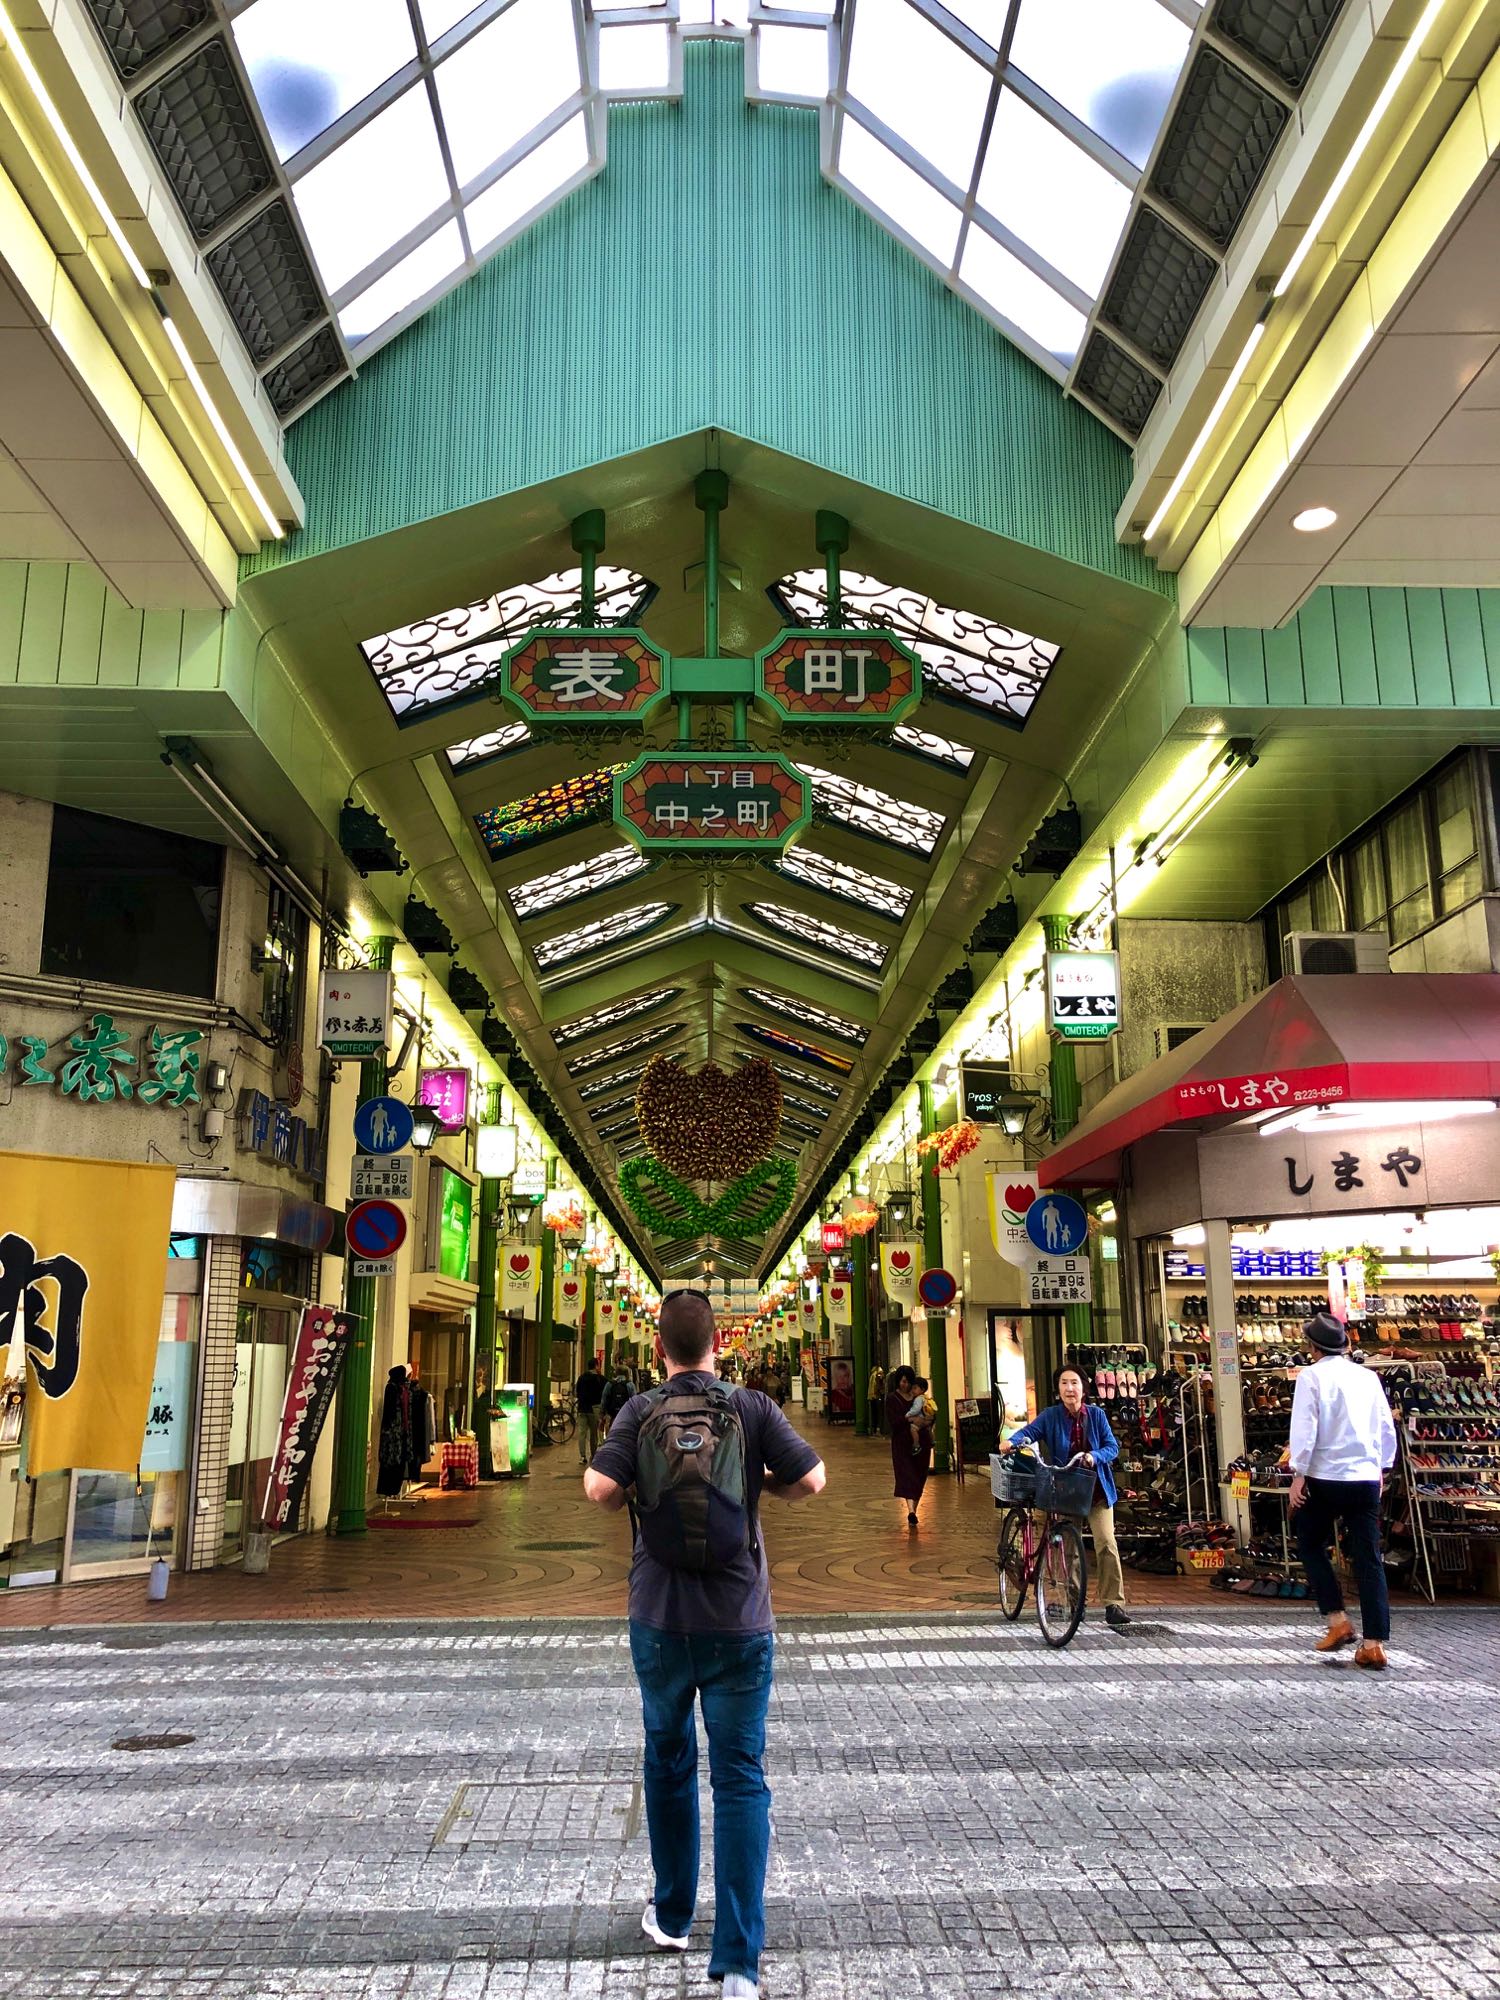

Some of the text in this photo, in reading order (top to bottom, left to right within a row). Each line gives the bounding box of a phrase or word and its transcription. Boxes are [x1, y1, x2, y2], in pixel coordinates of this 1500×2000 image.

[549, 648, 624, 702] 表
[804, 649, 873, 703] 町
[655, 800, 770, 831] 中之町
[329, 990, 351, 1001] 肉の
[1054, 997, 1116, 1016] しまや
[1180, 1084, 1216, 1098] はきもの
[1218, 1076, 1289, 1109] しまや
[1284, 1147, 1422, 1195] しまや
[355, 1185, 408, 1196] 自転車を除く
[1007, 1228, 1029, 1239] 中之
[357, 1264, 394, 1273] 2輪を除く
[509, 1281, 530, 1289] 中之町
[1032, 1288, 1087, 1300] 自転車を除く
